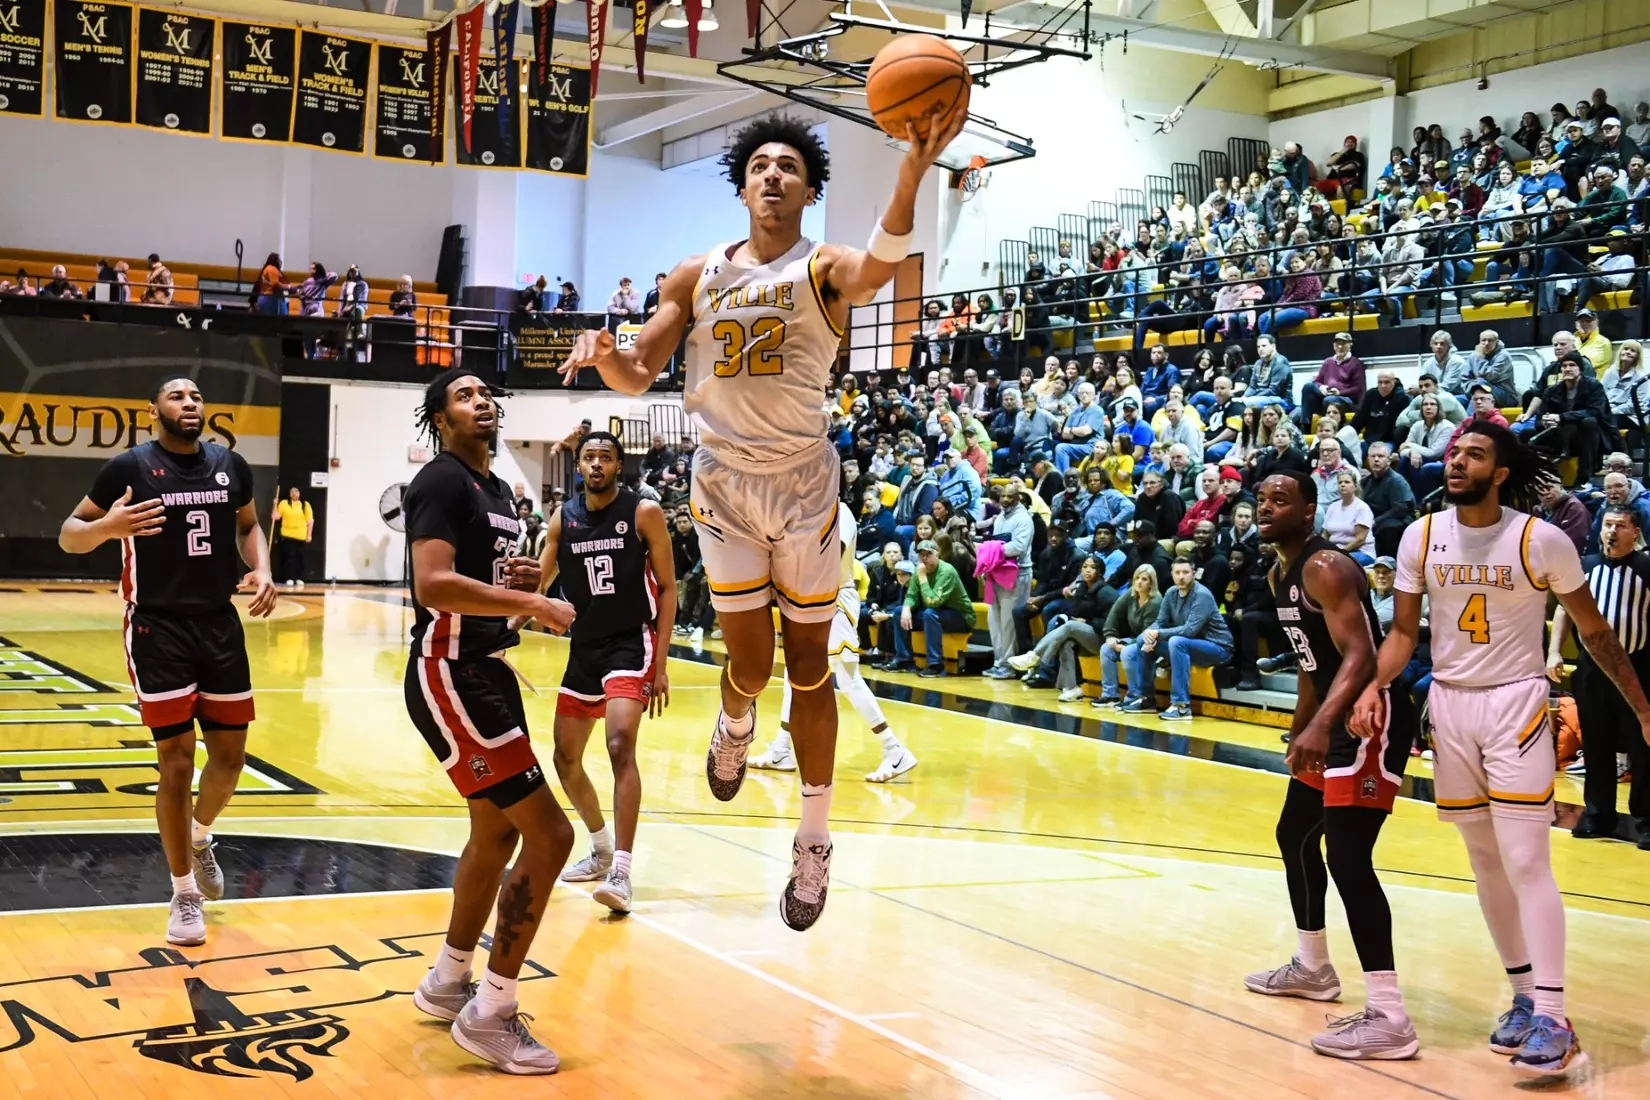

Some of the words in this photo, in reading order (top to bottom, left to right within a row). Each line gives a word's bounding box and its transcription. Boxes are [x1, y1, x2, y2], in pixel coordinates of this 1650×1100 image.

[83, 4, 105, 12] PSAC
[167, 15, 189, 24] PSAC
[249, 27, 271, 35] PSAC
[1, 33, 41, 46] SOCCER
[327, 37, 347, 47] PSAC
[64, 42, 92, 52] MEN'S
[93, 45, 123, 55] TENNIS
[404, 51, 423, 59] PSAC
[499, 4, 508, 96] LARION
[141, 51, 180, 63] WOMEN'S
[181, 56, 210, 68] TENNIS
[246, 64, 273, 74] MEN'S
[463, 20, 473, 124] CALIFORNIA
[552, 66, 570, 75] PSAC
[228, 71, 257, 81] TRACK
[259, 74, 265, 82] &
[267, 75, 290, 85] FIELD
[314, 73, 354, 87] WOMEN'S
[302, 78, 330, 91] TRACK
[341, 86, 364, 97] FIELD
[380, 85, 407, 95] WOMEN'S
[569, 104, 590, 114] GOLF
[708, 281, 795, 314] VILLE
[1013, 309, 1023, 338] D
[548, 337, 574, 345] ASSOC
[712, 316, 787, 378] 32
[161, 490, 229, 506] WARRIORS
[186, 510, 212, 556] 2
[571, 538, 625, 554] WARRIORS
[584, 555, 616, 596] 12
[1432, 564, 1515, 591] VILLE
[1458, 594, 1491, 644] 4
[1283, 626, 1317, 672] 3
